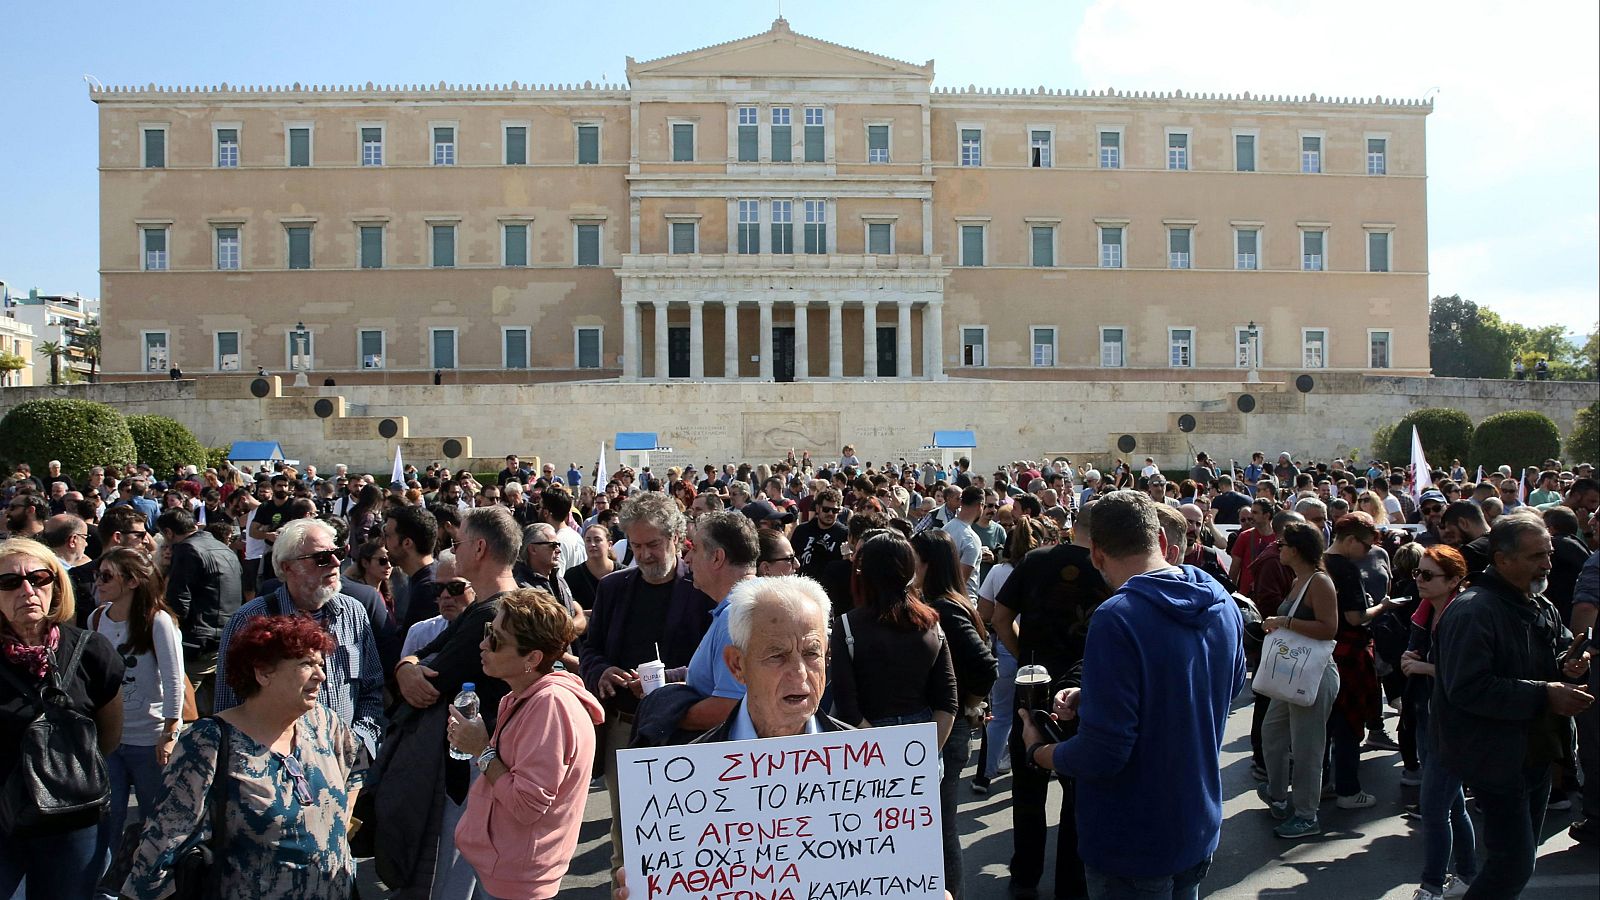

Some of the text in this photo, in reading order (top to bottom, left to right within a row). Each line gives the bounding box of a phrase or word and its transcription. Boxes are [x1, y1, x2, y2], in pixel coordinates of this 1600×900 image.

[633, 740, 926, 786] ΤΟ ΣΥΝΤΑΓΜΑ Ο
[640, 788, 736, 821] ΛΑΟΣ
[750, 784, 787, 811] ΤΟ
[635, 806, 933, 846] ΜΕ ΑΓΩΝΕΣ ΤΟ 1843
[641, 834, 896, 877] ΚΑΙ ΟΧΙ ΜΕ ΧΟΥΝΤΑ
[647, 863, 801, 900] ΚΑΘΑΡΜΑ
[807, 874, 940, 900] ΚΑΤΑΚΤΑΜΕ
